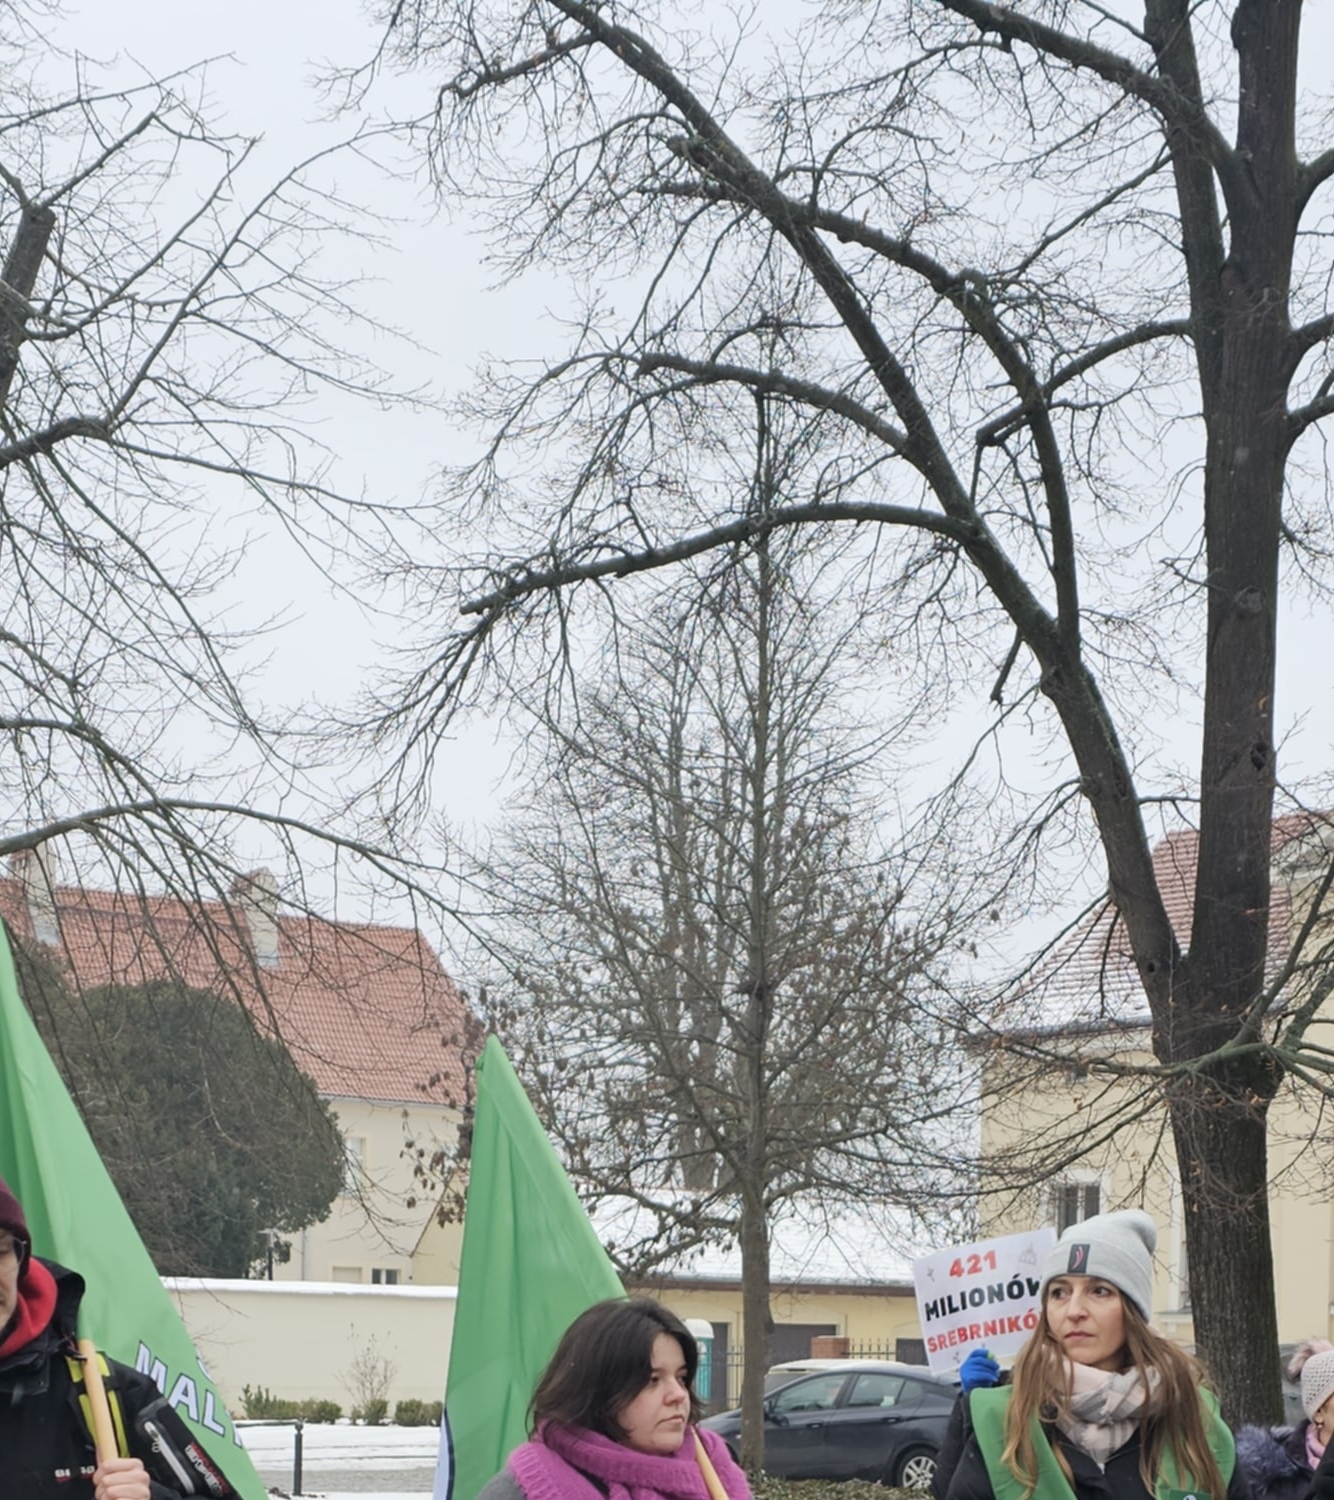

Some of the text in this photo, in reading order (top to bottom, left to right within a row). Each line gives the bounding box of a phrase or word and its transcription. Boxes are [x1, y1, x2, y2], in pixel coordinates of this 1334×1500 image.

[949, 1250, 997, 1278] 421
[927, 1308, 1039, 1353] SREBRNIKÓ
[134, 1340, 244, 1449] MAL
